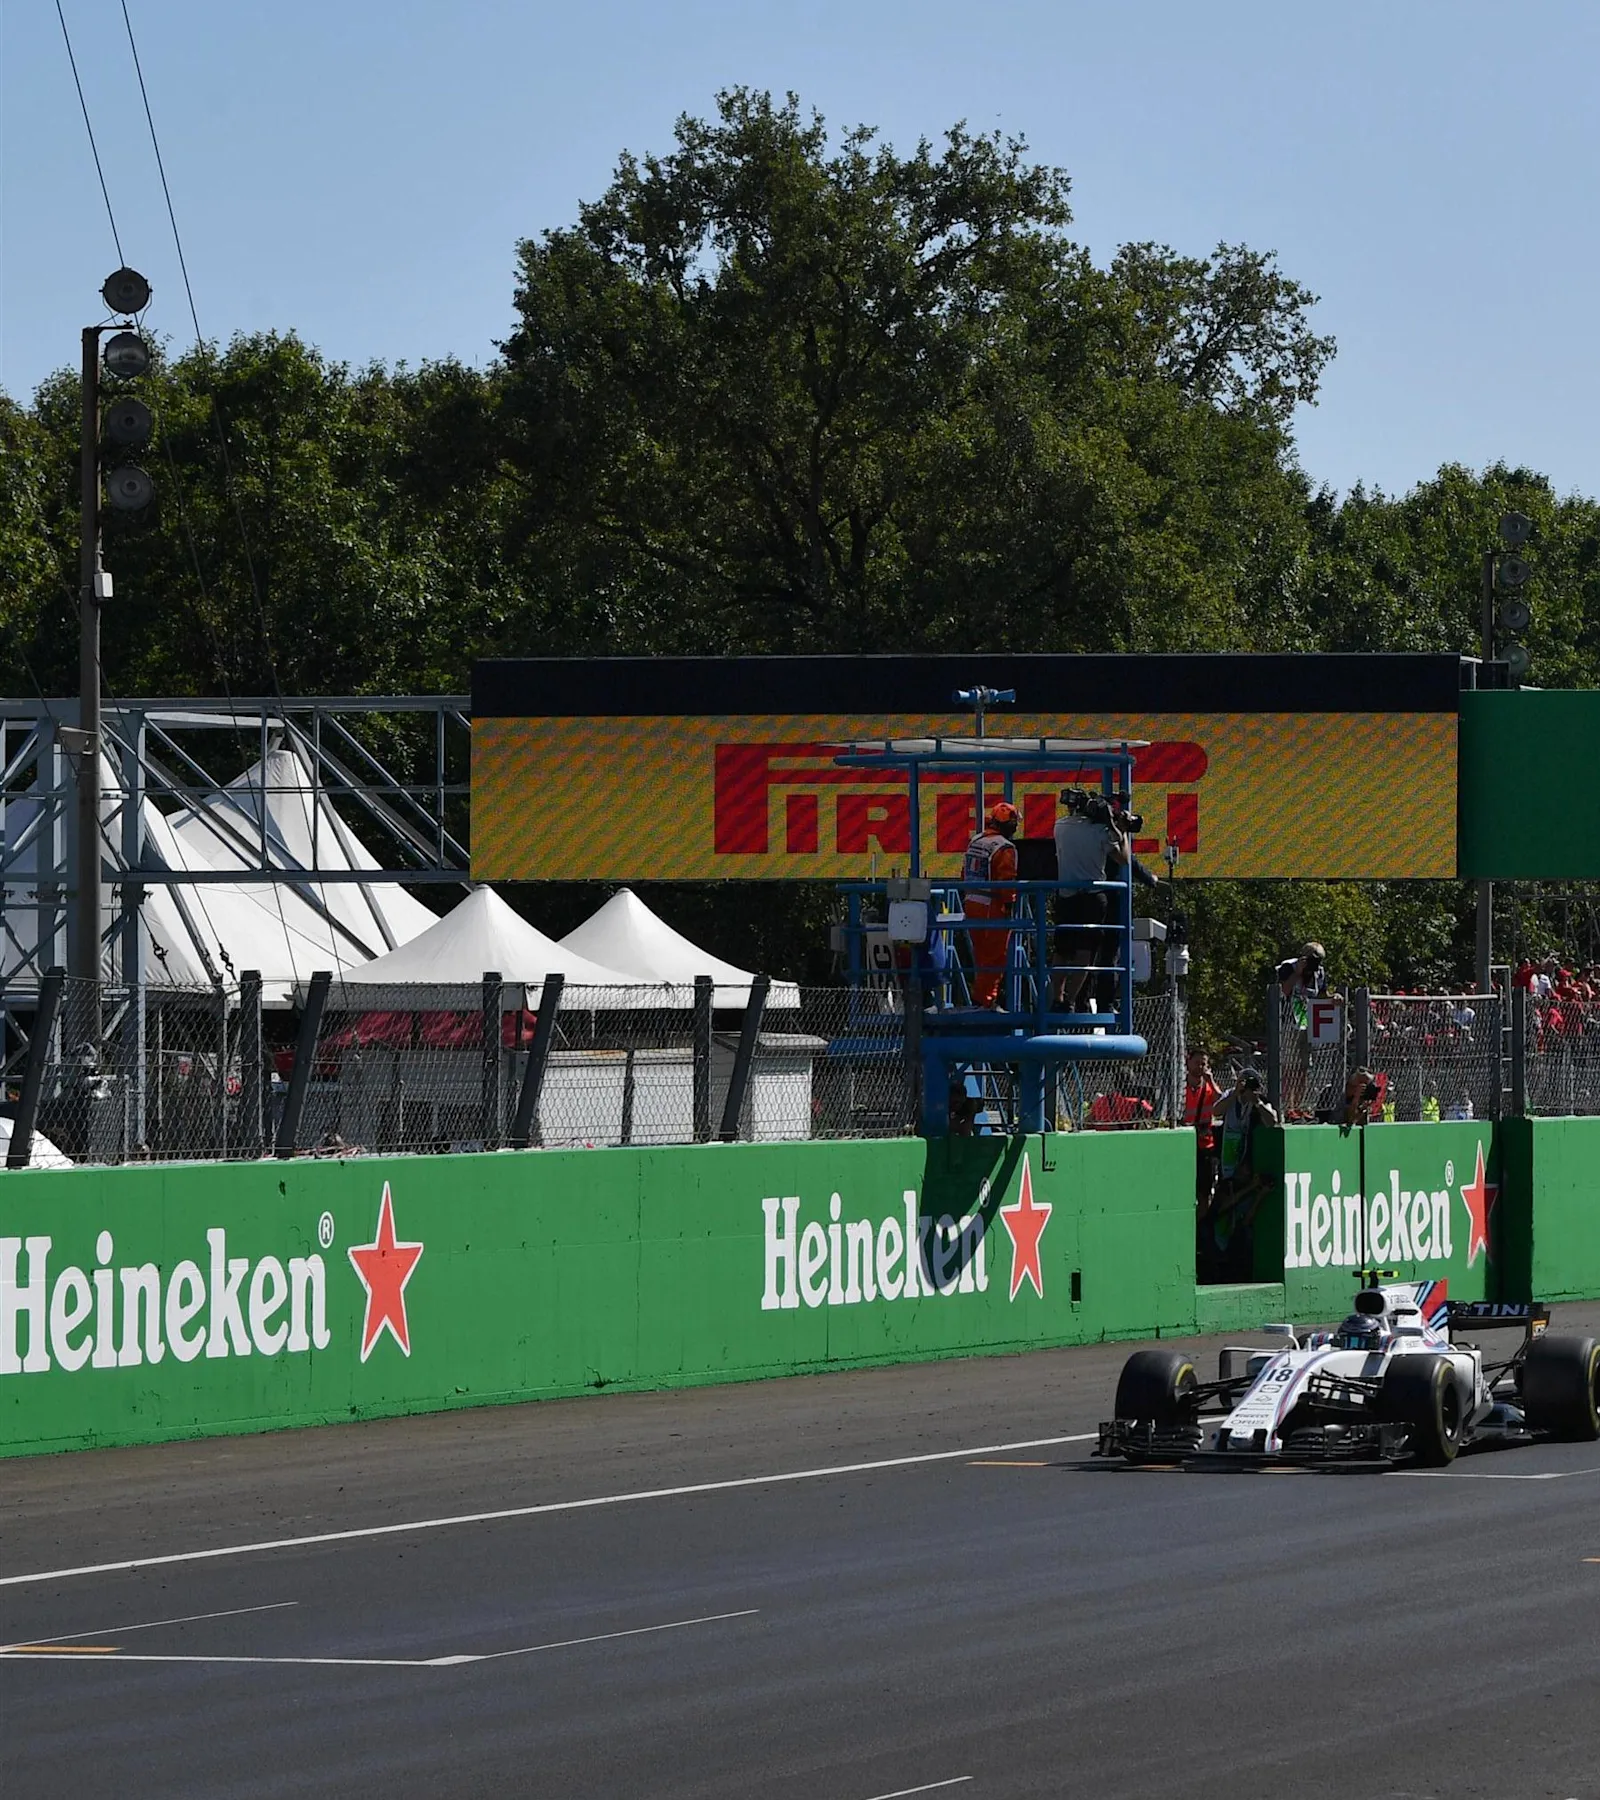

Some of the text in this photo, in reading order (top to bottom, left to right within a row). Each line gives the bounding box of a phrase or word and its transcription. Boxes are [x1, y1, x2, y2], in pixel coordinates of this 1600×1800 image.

[1312, 1003, 1335, 1038] F
[760, 1190, 989, 1311] Heineken
[1284, 1169, 1453, 1269] Heineken
[0, 1227, 331, 1375] Heineken
[1265, 1368, 1294, 1382] 18
